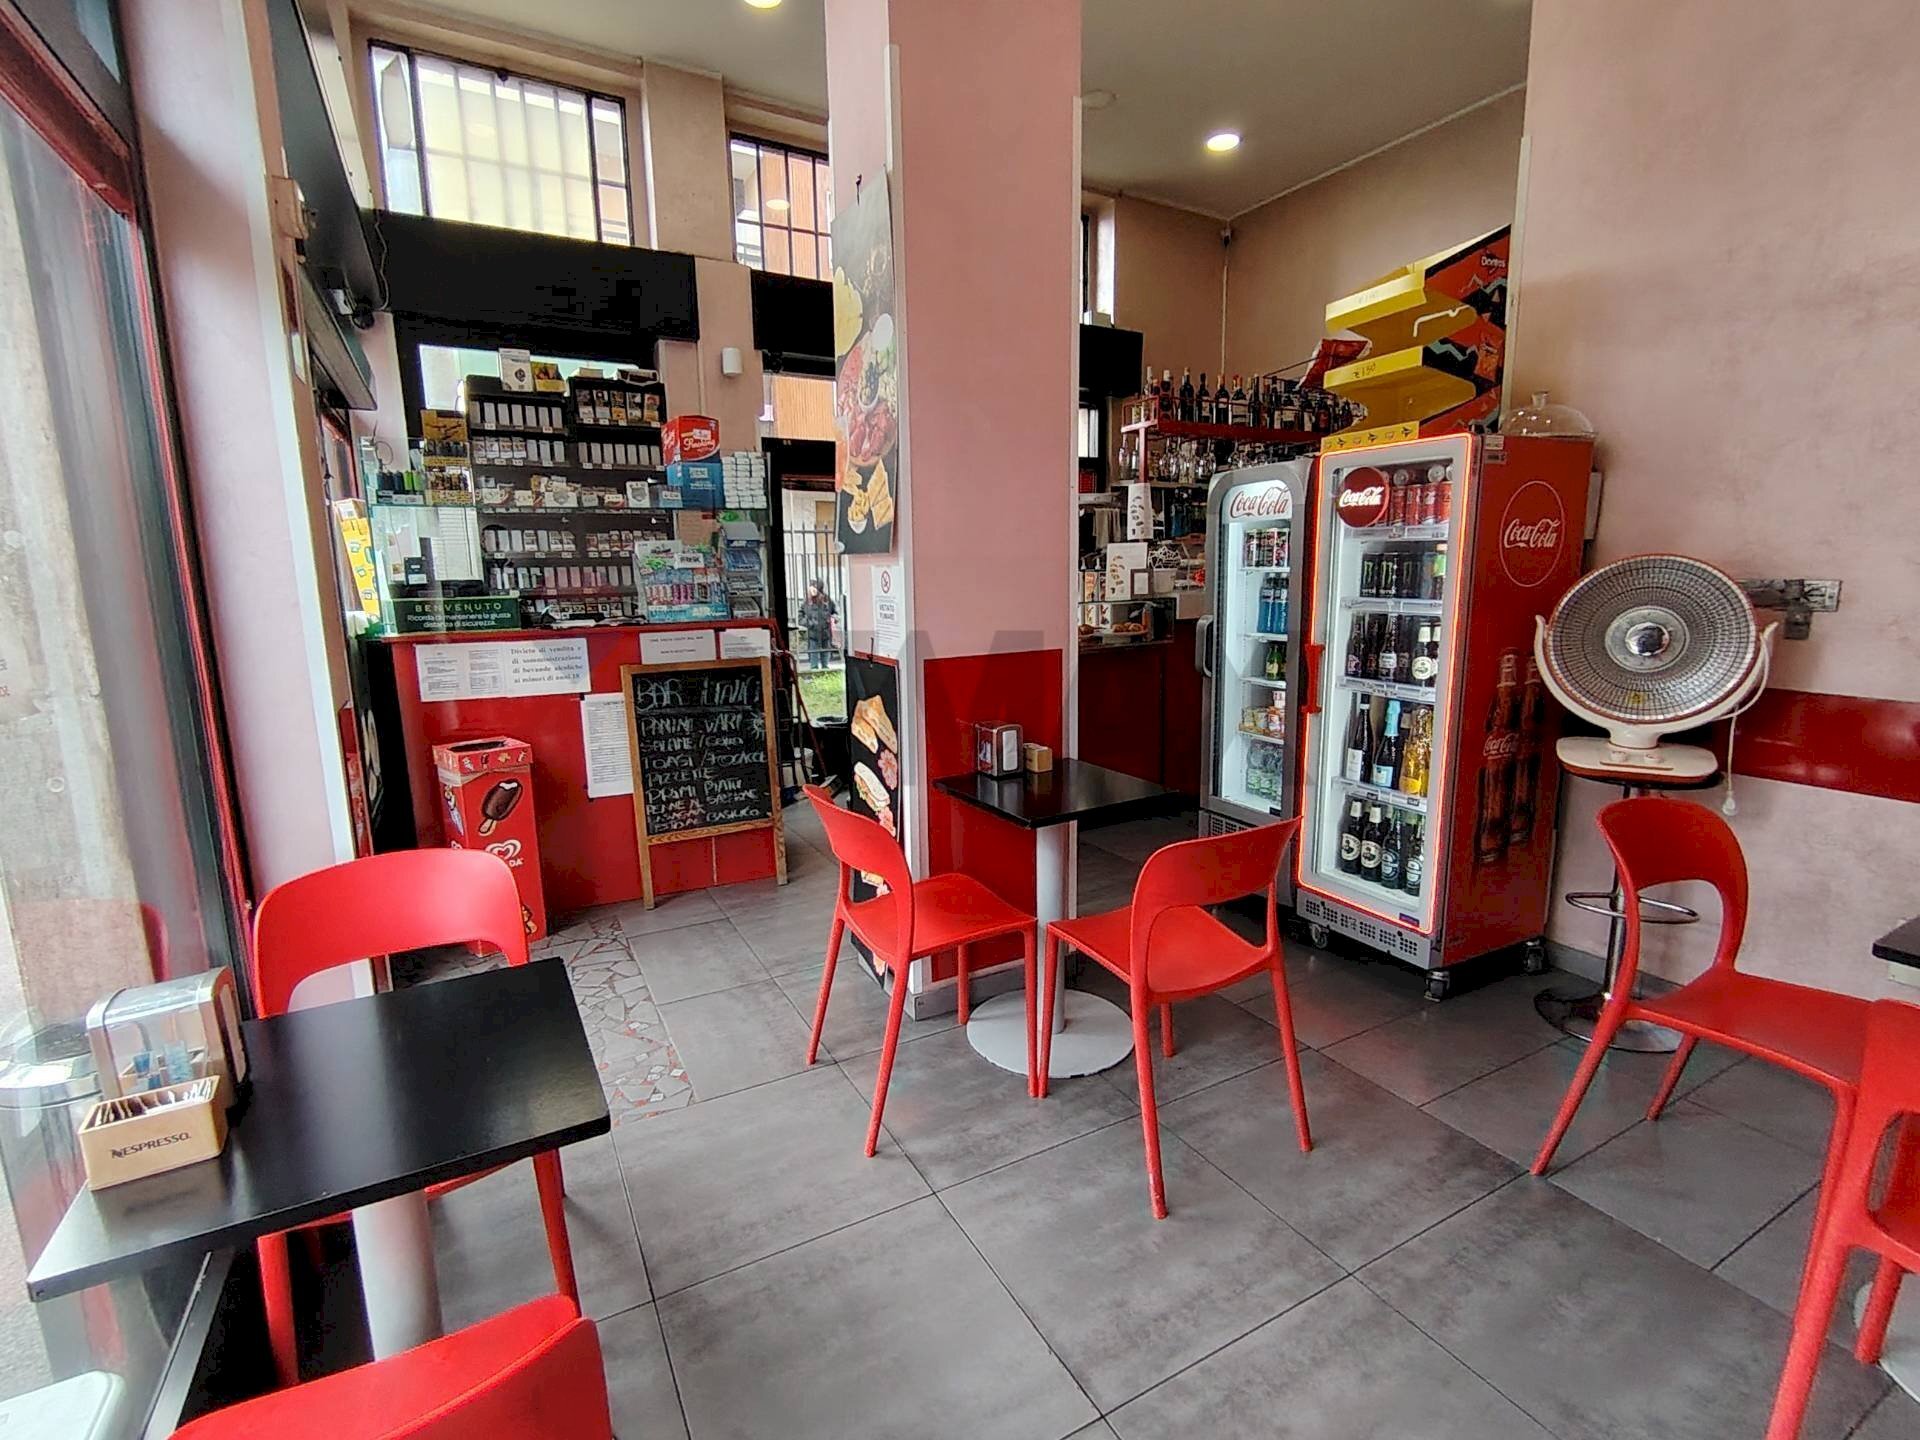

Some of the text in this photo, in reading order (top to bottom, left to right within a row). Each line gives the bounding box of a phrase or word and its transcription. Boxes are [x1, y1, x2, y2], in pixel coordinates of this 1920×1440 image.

[415, 602, 502, 612] BENVENUTO
[636, 678, 683, 711] BAR
[110, 1132, 191, 1159] NESPRESSO
